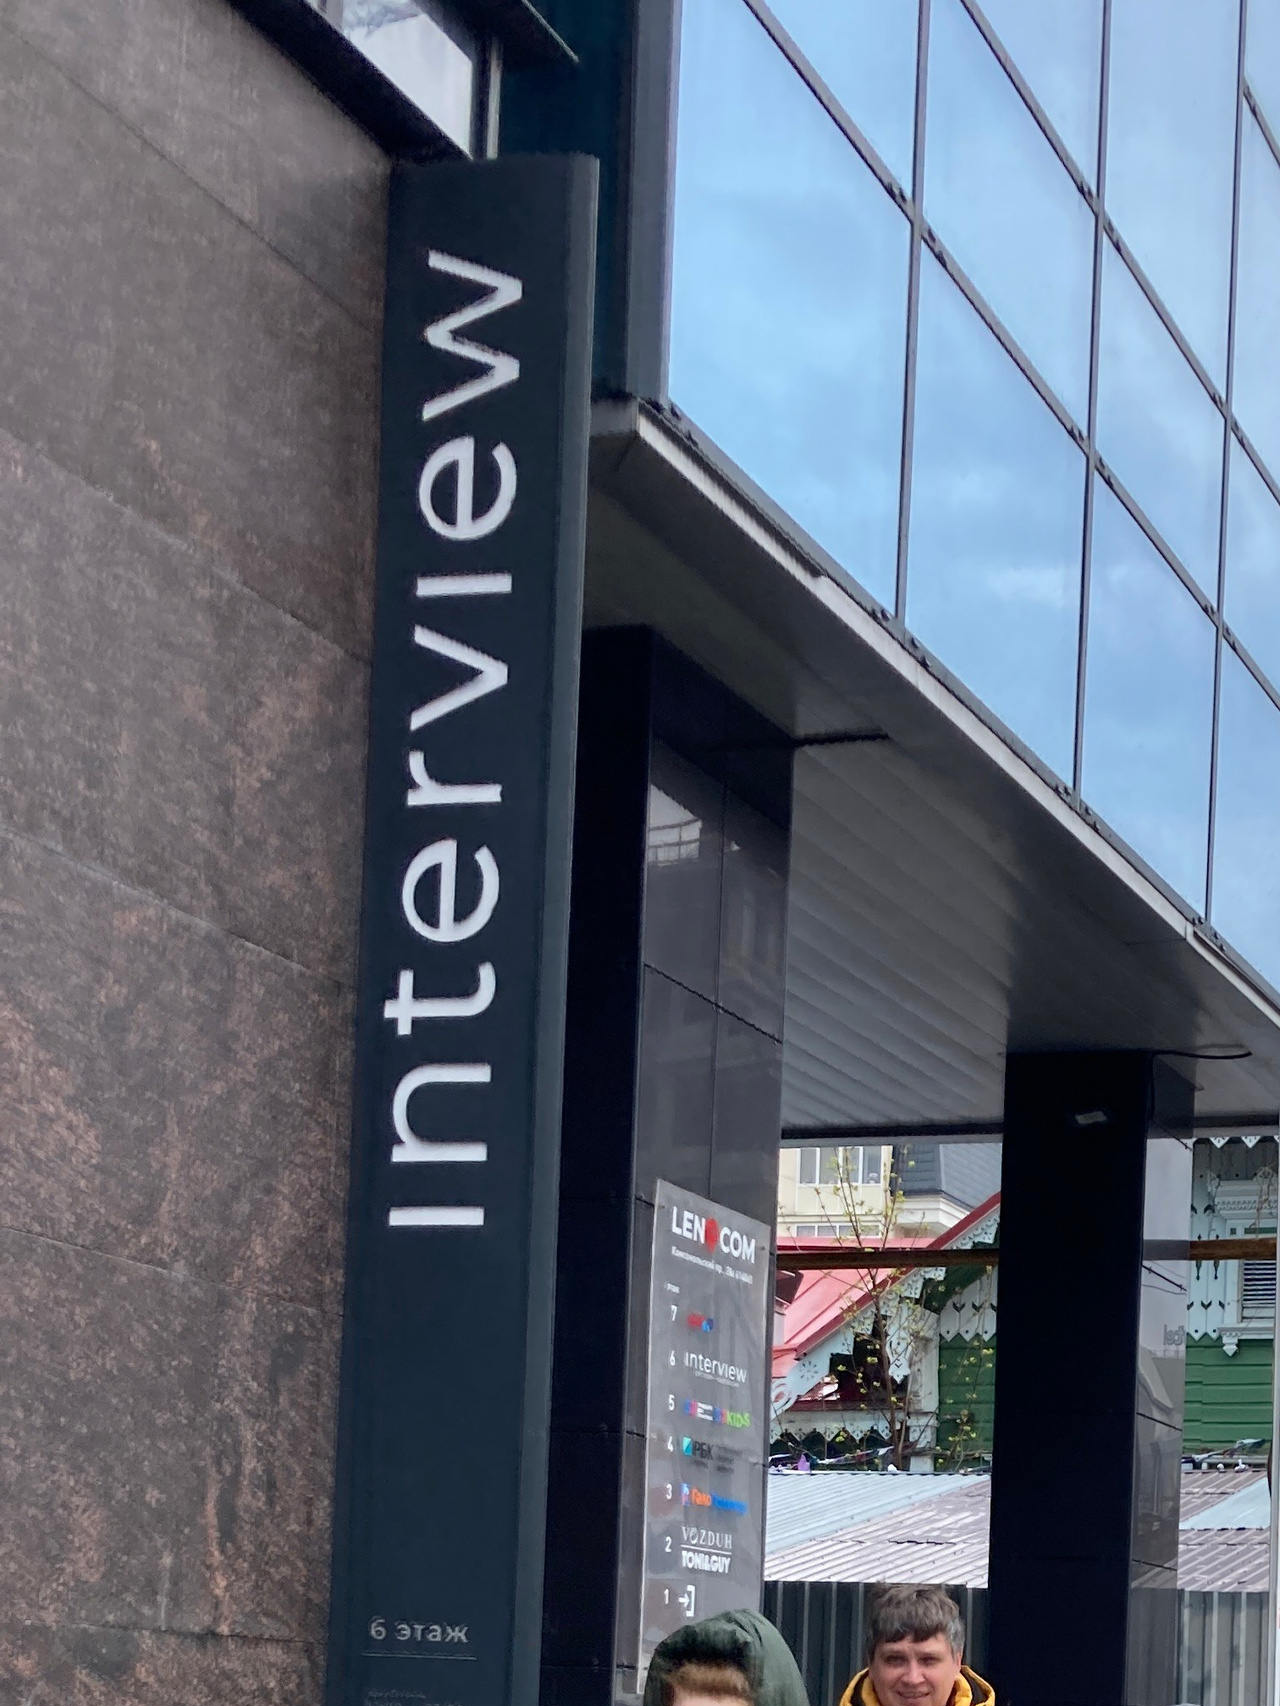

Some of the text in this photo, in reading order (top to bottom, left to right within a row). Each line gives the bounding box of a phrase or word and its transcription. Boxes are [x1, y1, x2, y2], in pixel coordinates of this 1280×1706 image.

[383, 249, 524, 1227] interview
[671, 1305, 678, 1321] 7
[669, 1350, 676, 1366] 6
[684, 1351, 747, 1383] interview
[668, 1394, 675, 1411] 5
[667, 1437, 674, 1452] 4
[666, 1484, 673, 1500] 3
[664, 1526, 733, 1552] 2 VOZDUH
[682, 1551, 730, 1573] TONI&GUY
[664, 1589, 670, 1605] 1
[369, 1618, 469, 1643] 6 этаж
